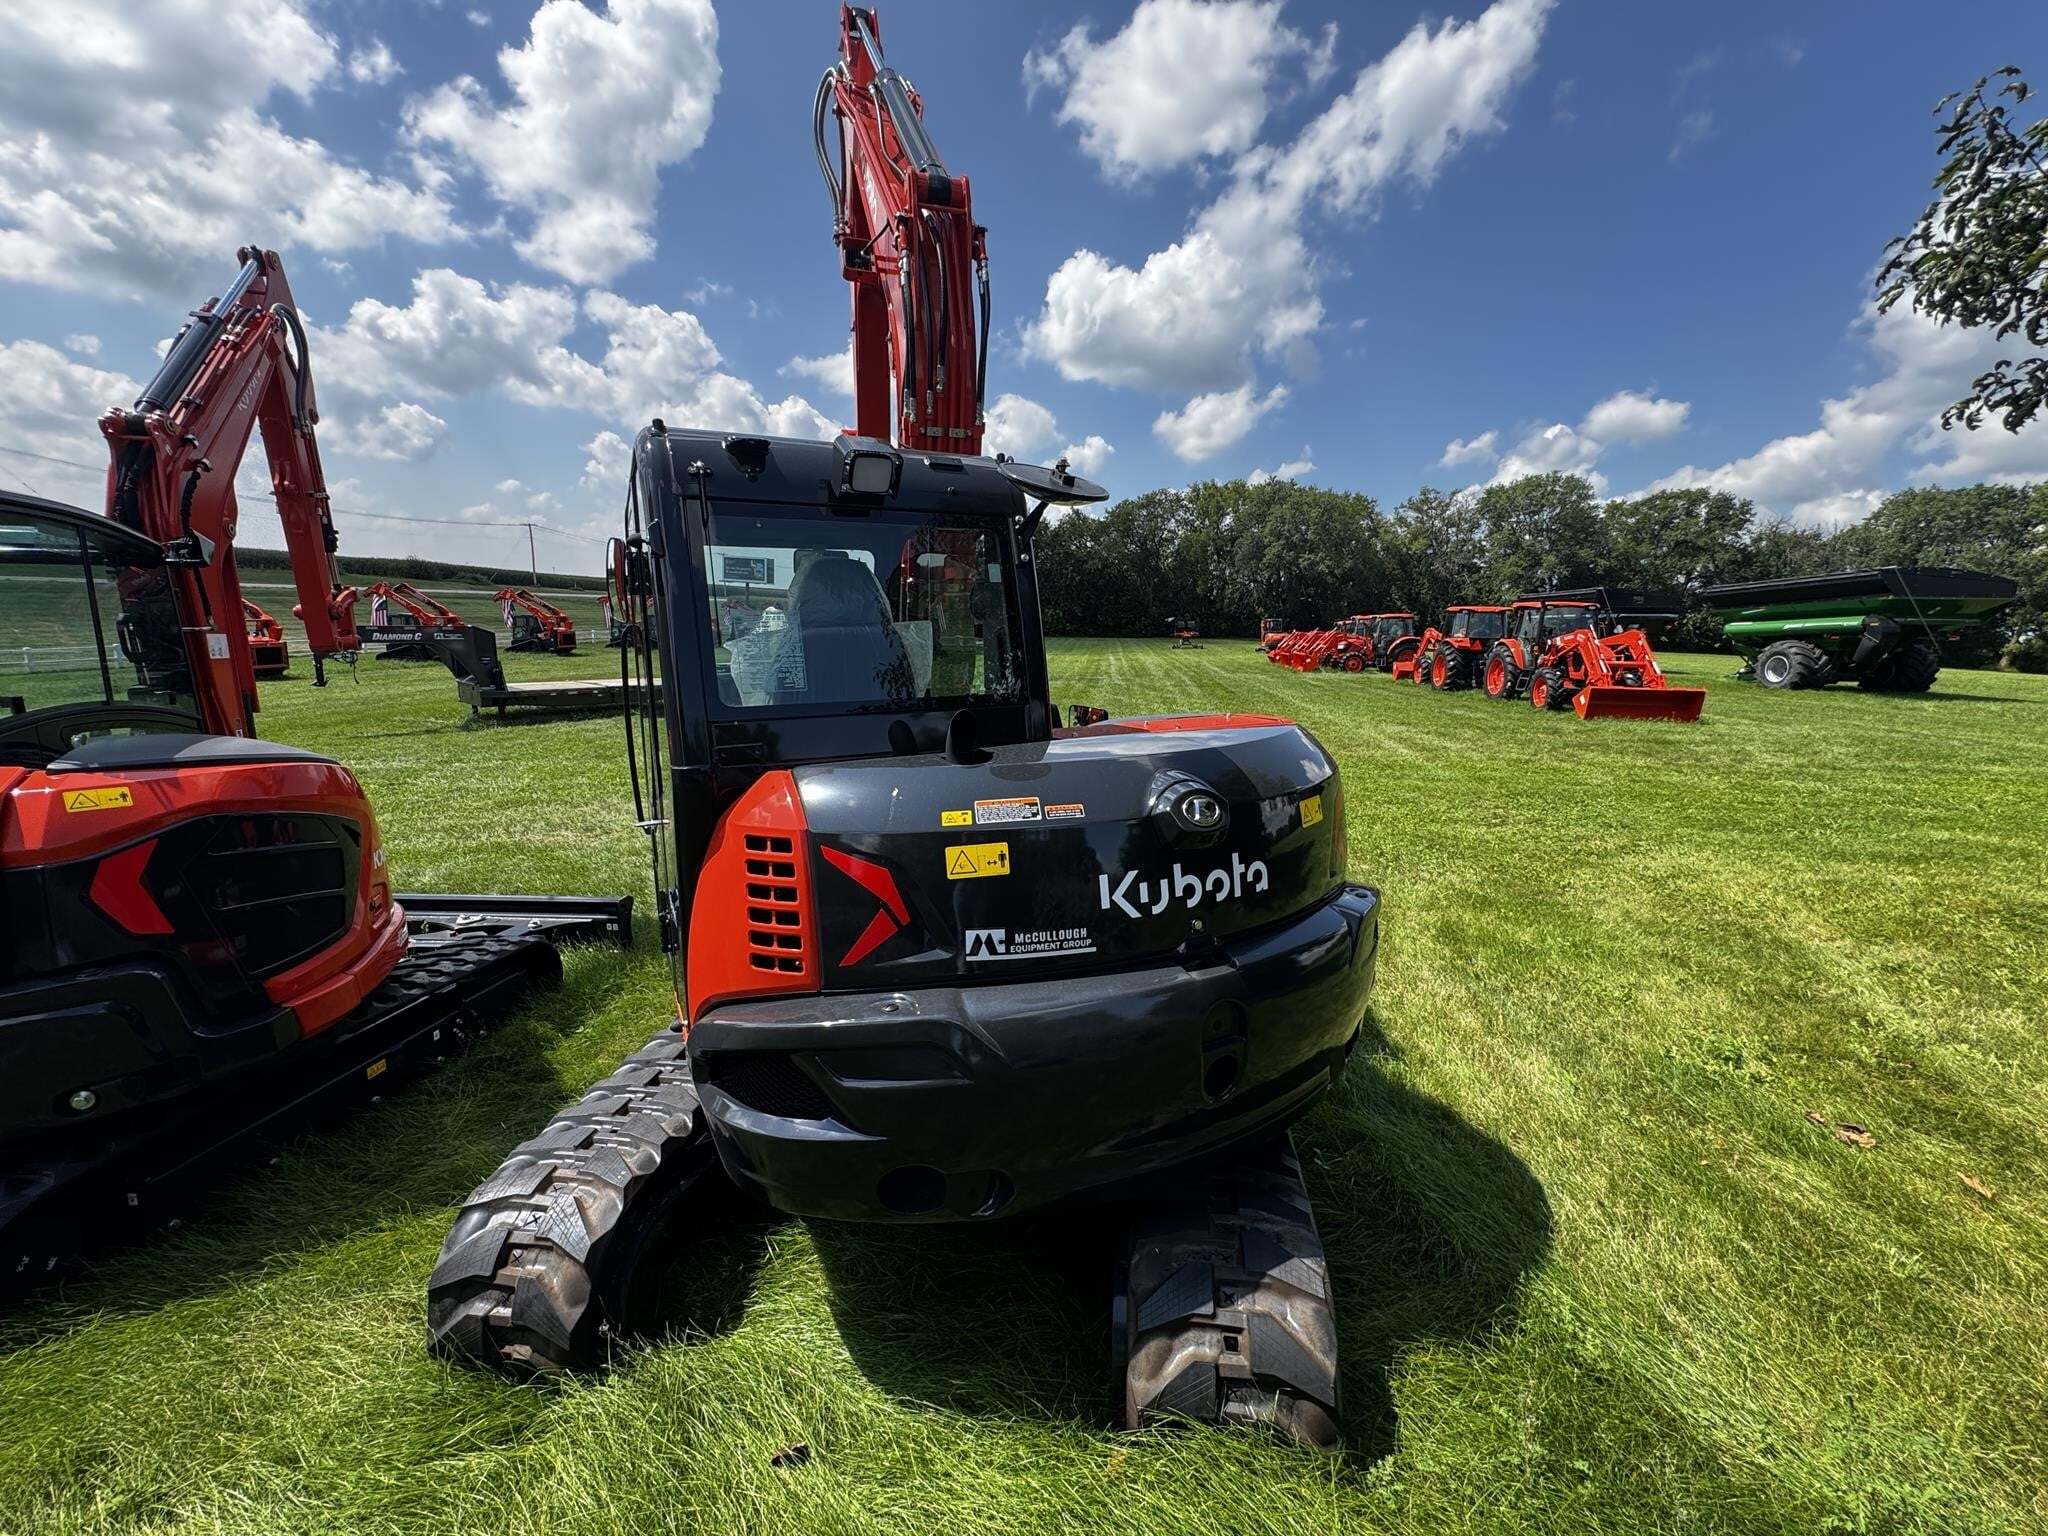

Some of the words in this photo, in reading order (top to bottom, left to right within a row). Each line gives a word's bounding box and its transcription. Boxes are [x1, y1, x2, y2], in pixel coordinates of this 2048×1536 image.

[372, 632, 413, 641] DIAMOND
[414, 632, 422, 641] C
[1098, 852, 1269, 919] Kubota
[1014, 927, 1087, 944] McCULLOUGH
[1010, 941, 1061, 953] EQUIPMENT
[1062, 938, 1092, 948] GROUP
